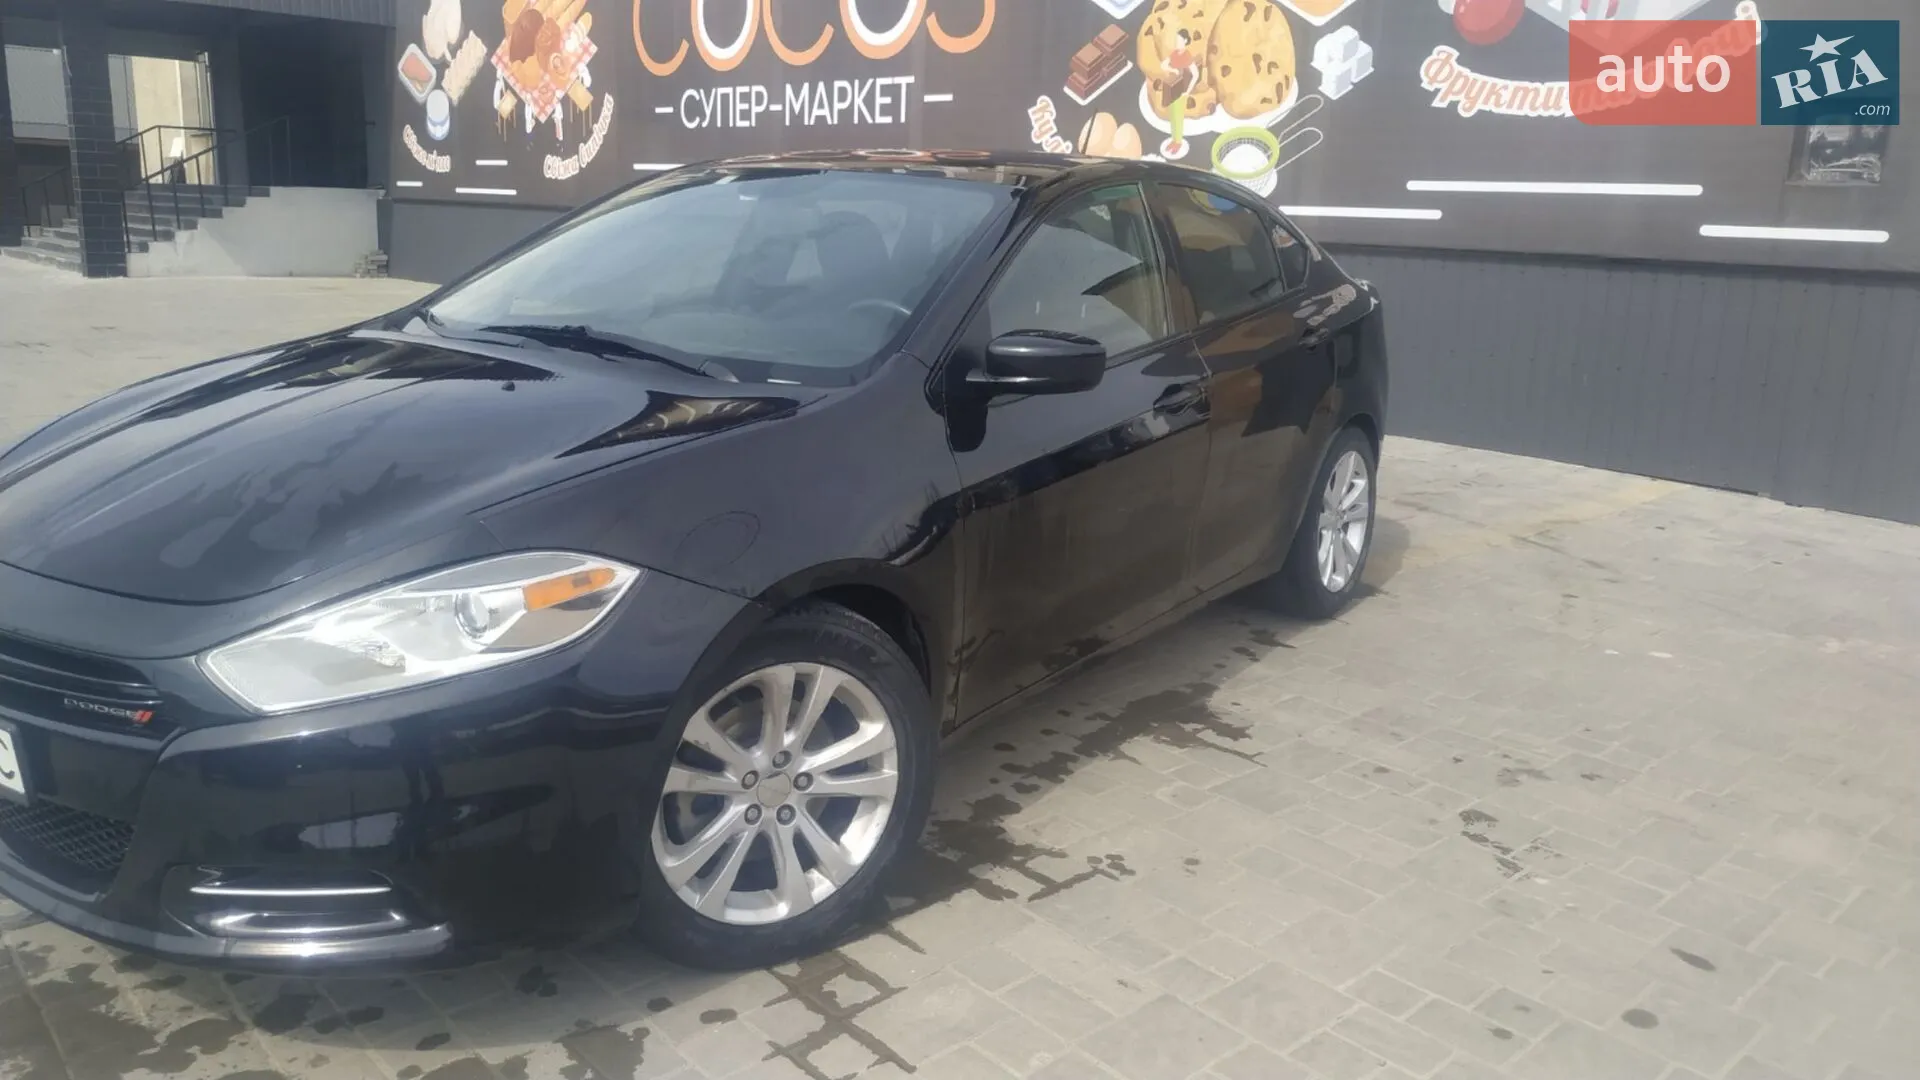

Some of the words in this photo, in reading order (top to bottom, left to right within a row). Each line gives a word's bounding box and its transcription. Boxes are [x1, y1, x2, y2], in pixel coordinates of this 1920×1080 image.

[680, 75, 915, 129] СУПЕР-МАРКЕТ
[1420, 46, 1565, 116] Фрукти
[63, 697, 138, 721] DODGE
